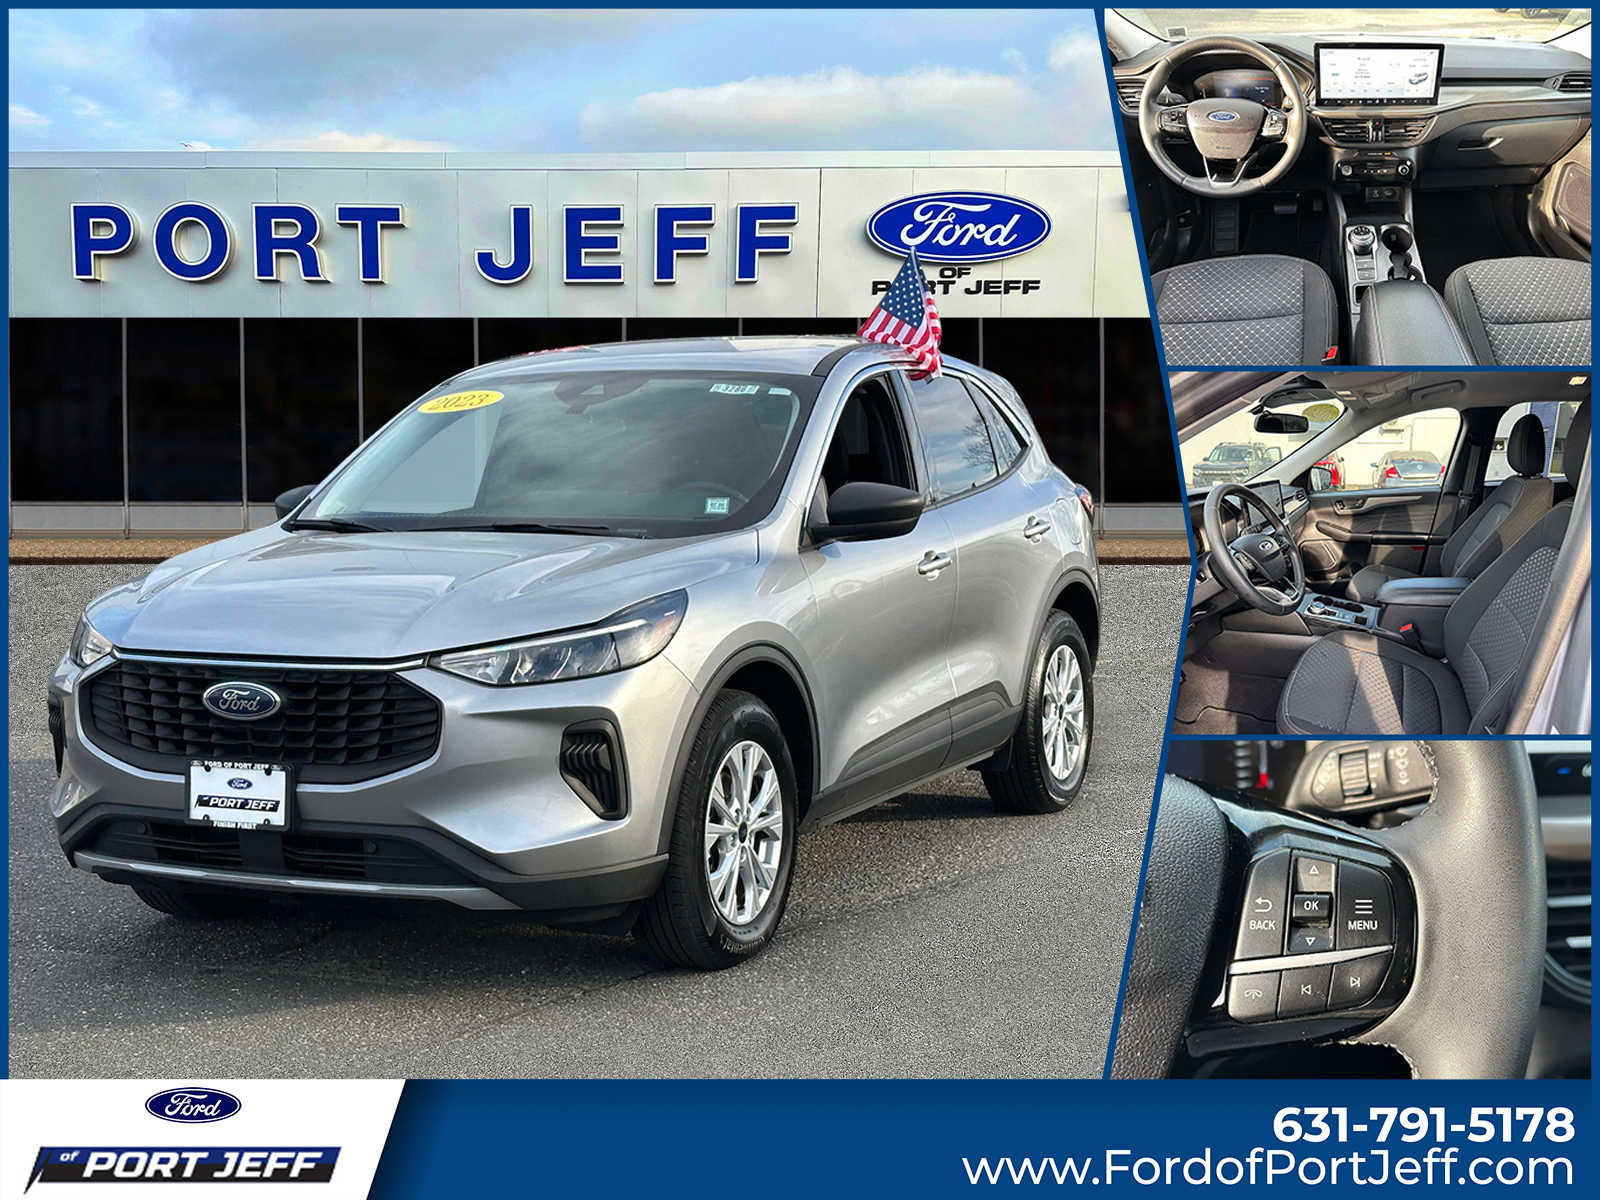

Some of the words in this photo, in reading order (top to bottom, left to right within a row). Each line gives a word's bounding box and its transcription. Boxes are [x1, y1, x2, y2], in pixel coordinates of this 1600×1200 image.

[900, 201, 1022, 246] Ford
[70, 201, 406, 284] PORT
[475, 203, 799, 285] JEFF
[939, 267, 971, 279] OF
[964, 280, 1041, 295] JEFF
[426, 393, 490, 411] 2023
[219, 689, 260, 711] Ford
[209, 797, 244, 809] PORT
[245, 800, 276, 811] JEFF
[1304, 901, 1319, 911] OK
[1249, 920, 1276, 930] BACK
[1348, 920, 1378, 930] MENU
